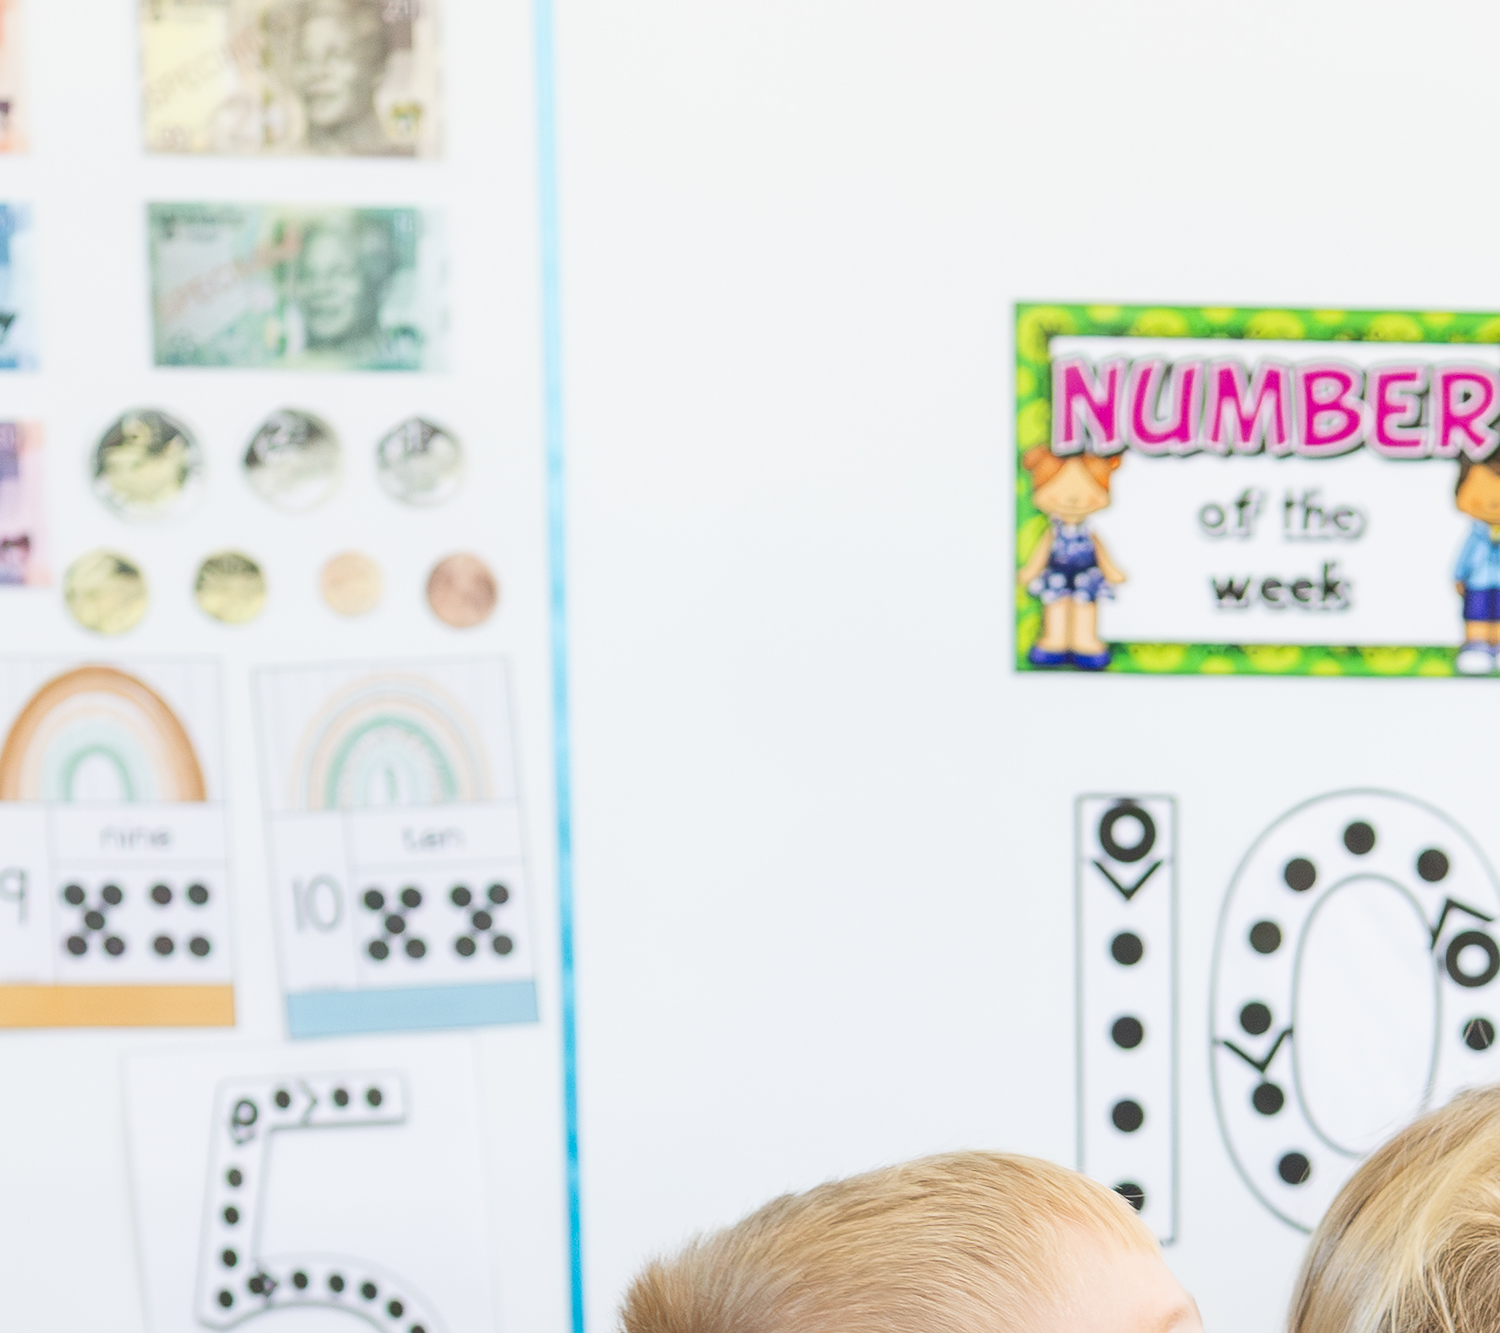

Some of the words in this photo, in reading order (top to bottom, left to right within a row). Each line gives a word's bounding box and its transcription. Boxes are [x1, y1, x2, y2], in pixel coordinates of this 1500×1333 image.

[1195, 485, 1268, 541] of
[1281, 487, 1366, 541] the
[1208, 558, 1353, 614] week
[100, 827, 173, 849] nine
[402, 828, 462, 851] ten
[291, 873, 346, 935] 10
